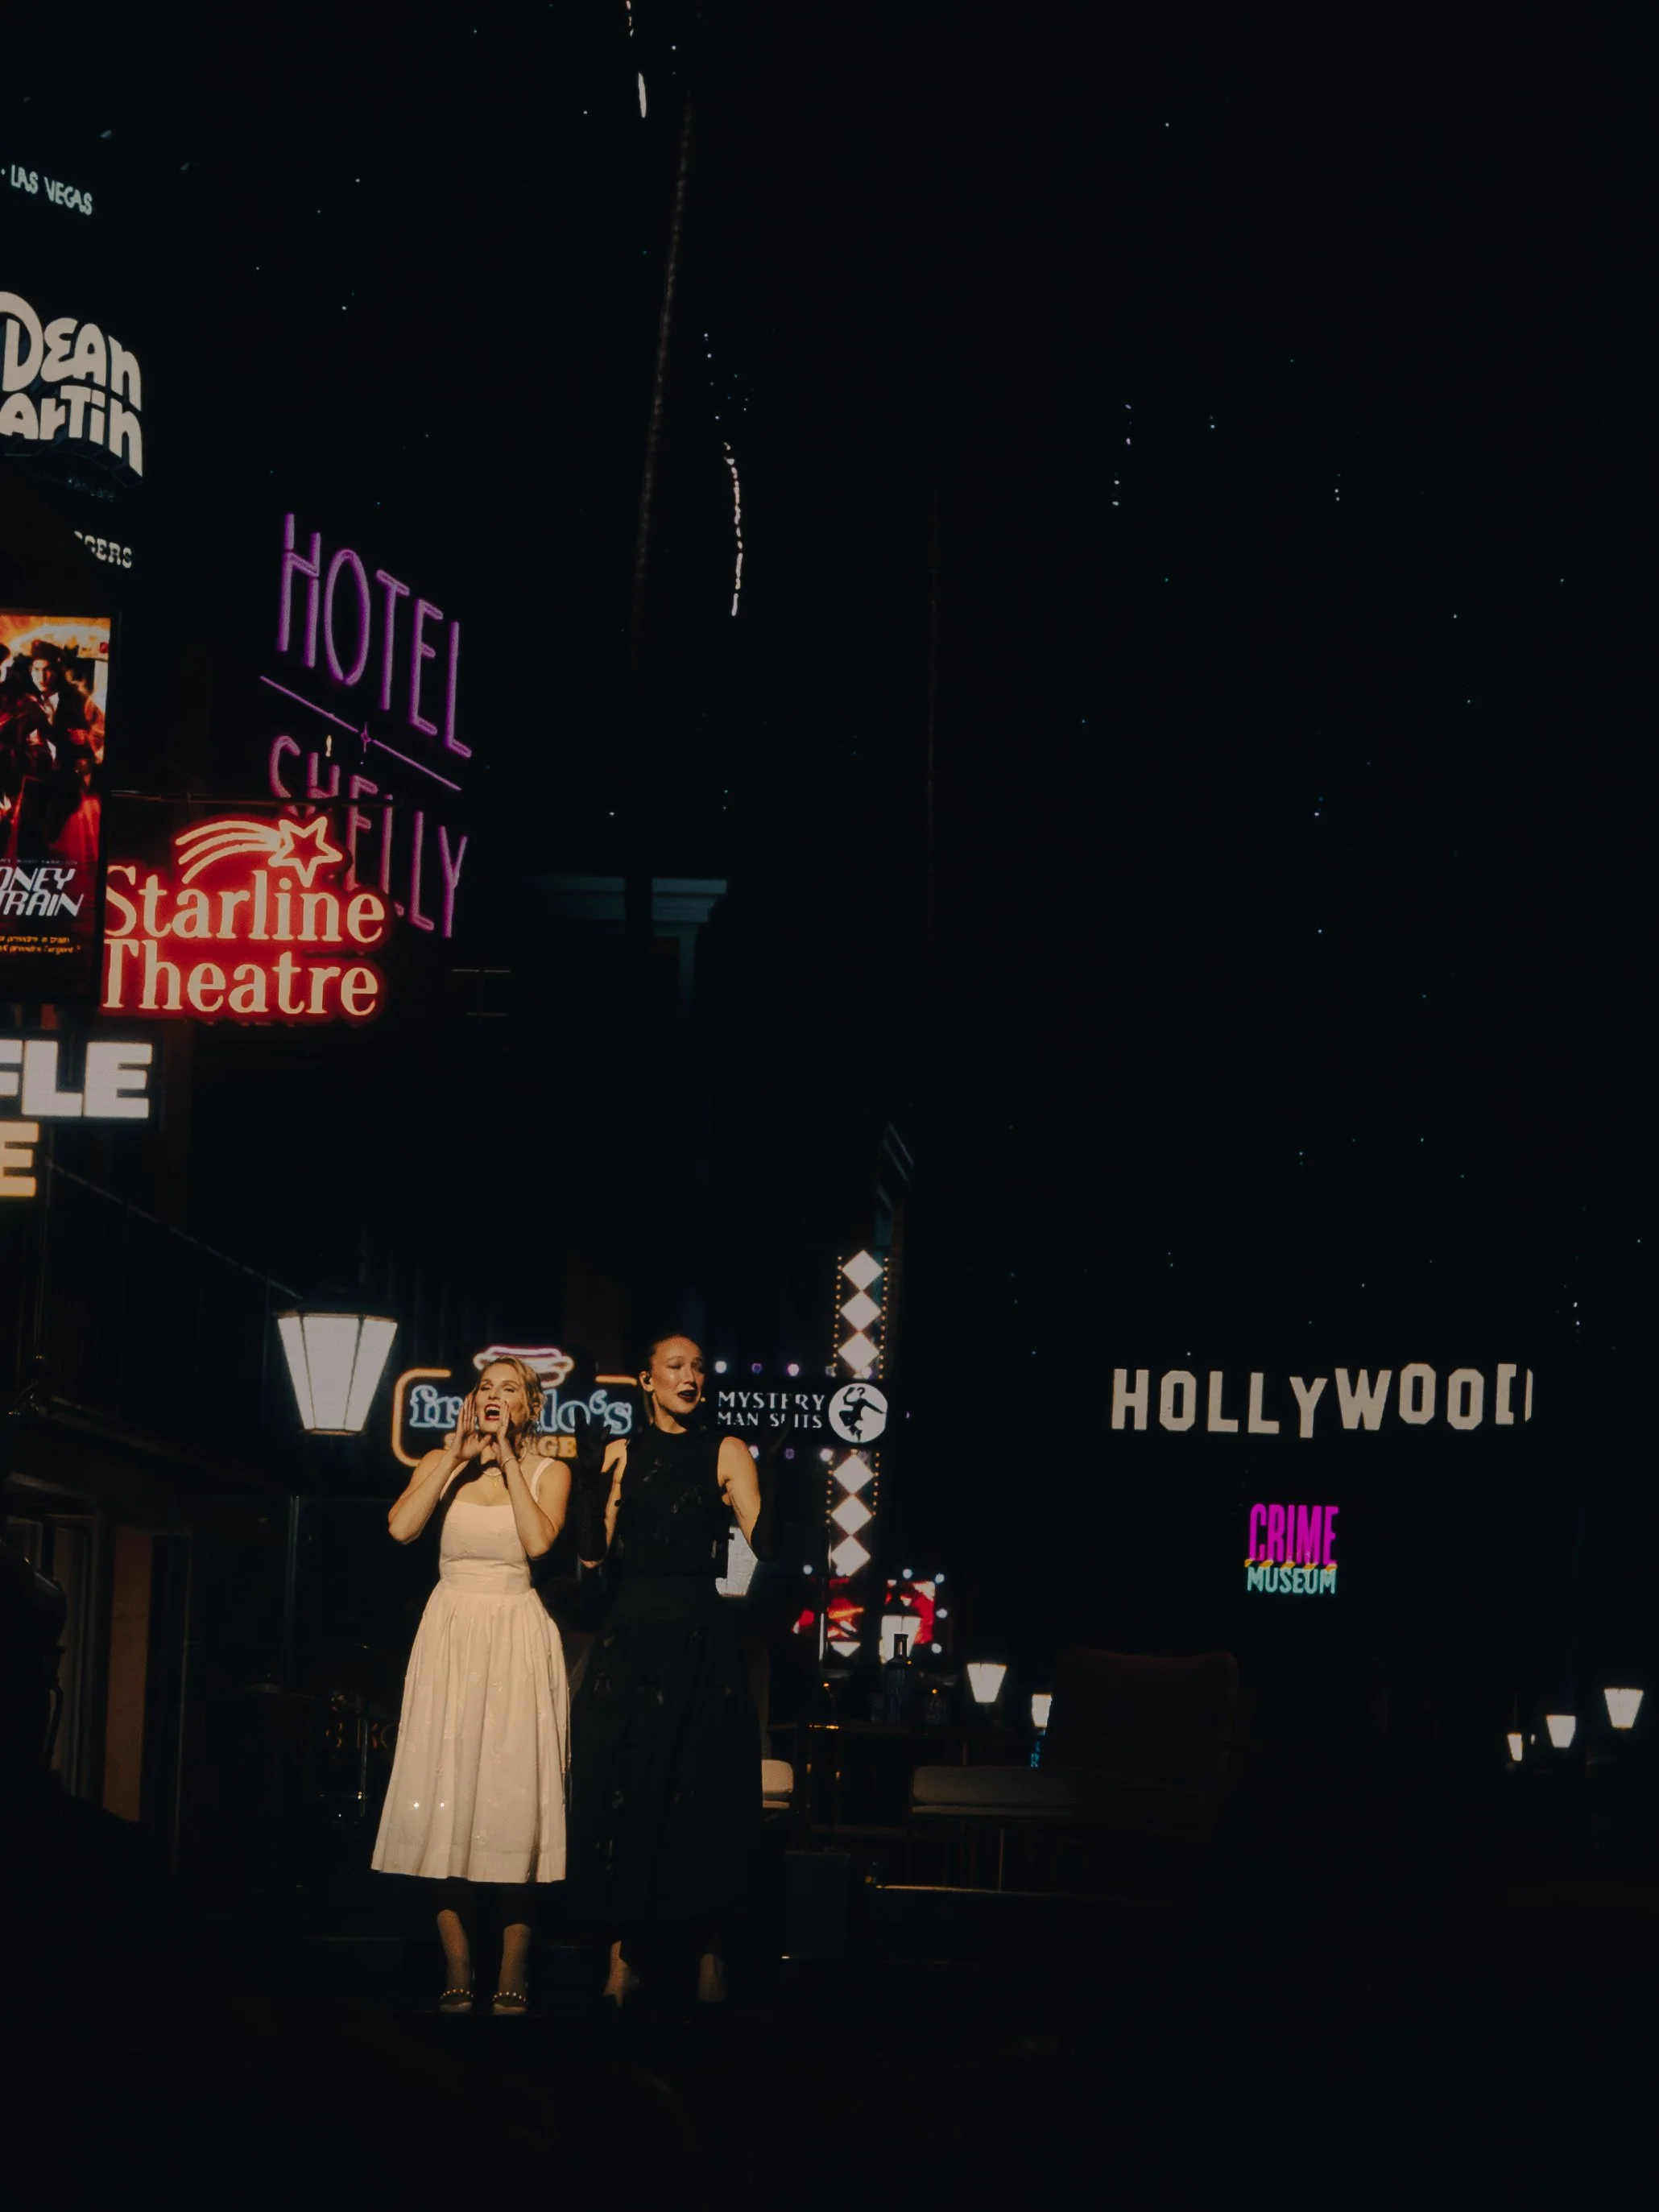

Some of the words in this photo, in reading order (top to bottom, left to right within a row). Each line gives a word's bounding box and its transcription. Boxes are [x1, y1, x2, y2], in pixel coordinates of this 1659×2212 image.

[10, 164, 39, 194] LAS
[43, 176, 93, 216] VEGAS
[275, 512, 472, 759] HOTEL
[103, 864, 387, 943] Starline
[101, 937, 382, 1016] Theatre
[717, 1411, 759, 1426] MAN
[718, 1391, 825, 1412] MYSTERY
[1249, 1503, 1340, 1565] CRIME
[1246, 1565, 1338, 1595] MUSEUM
